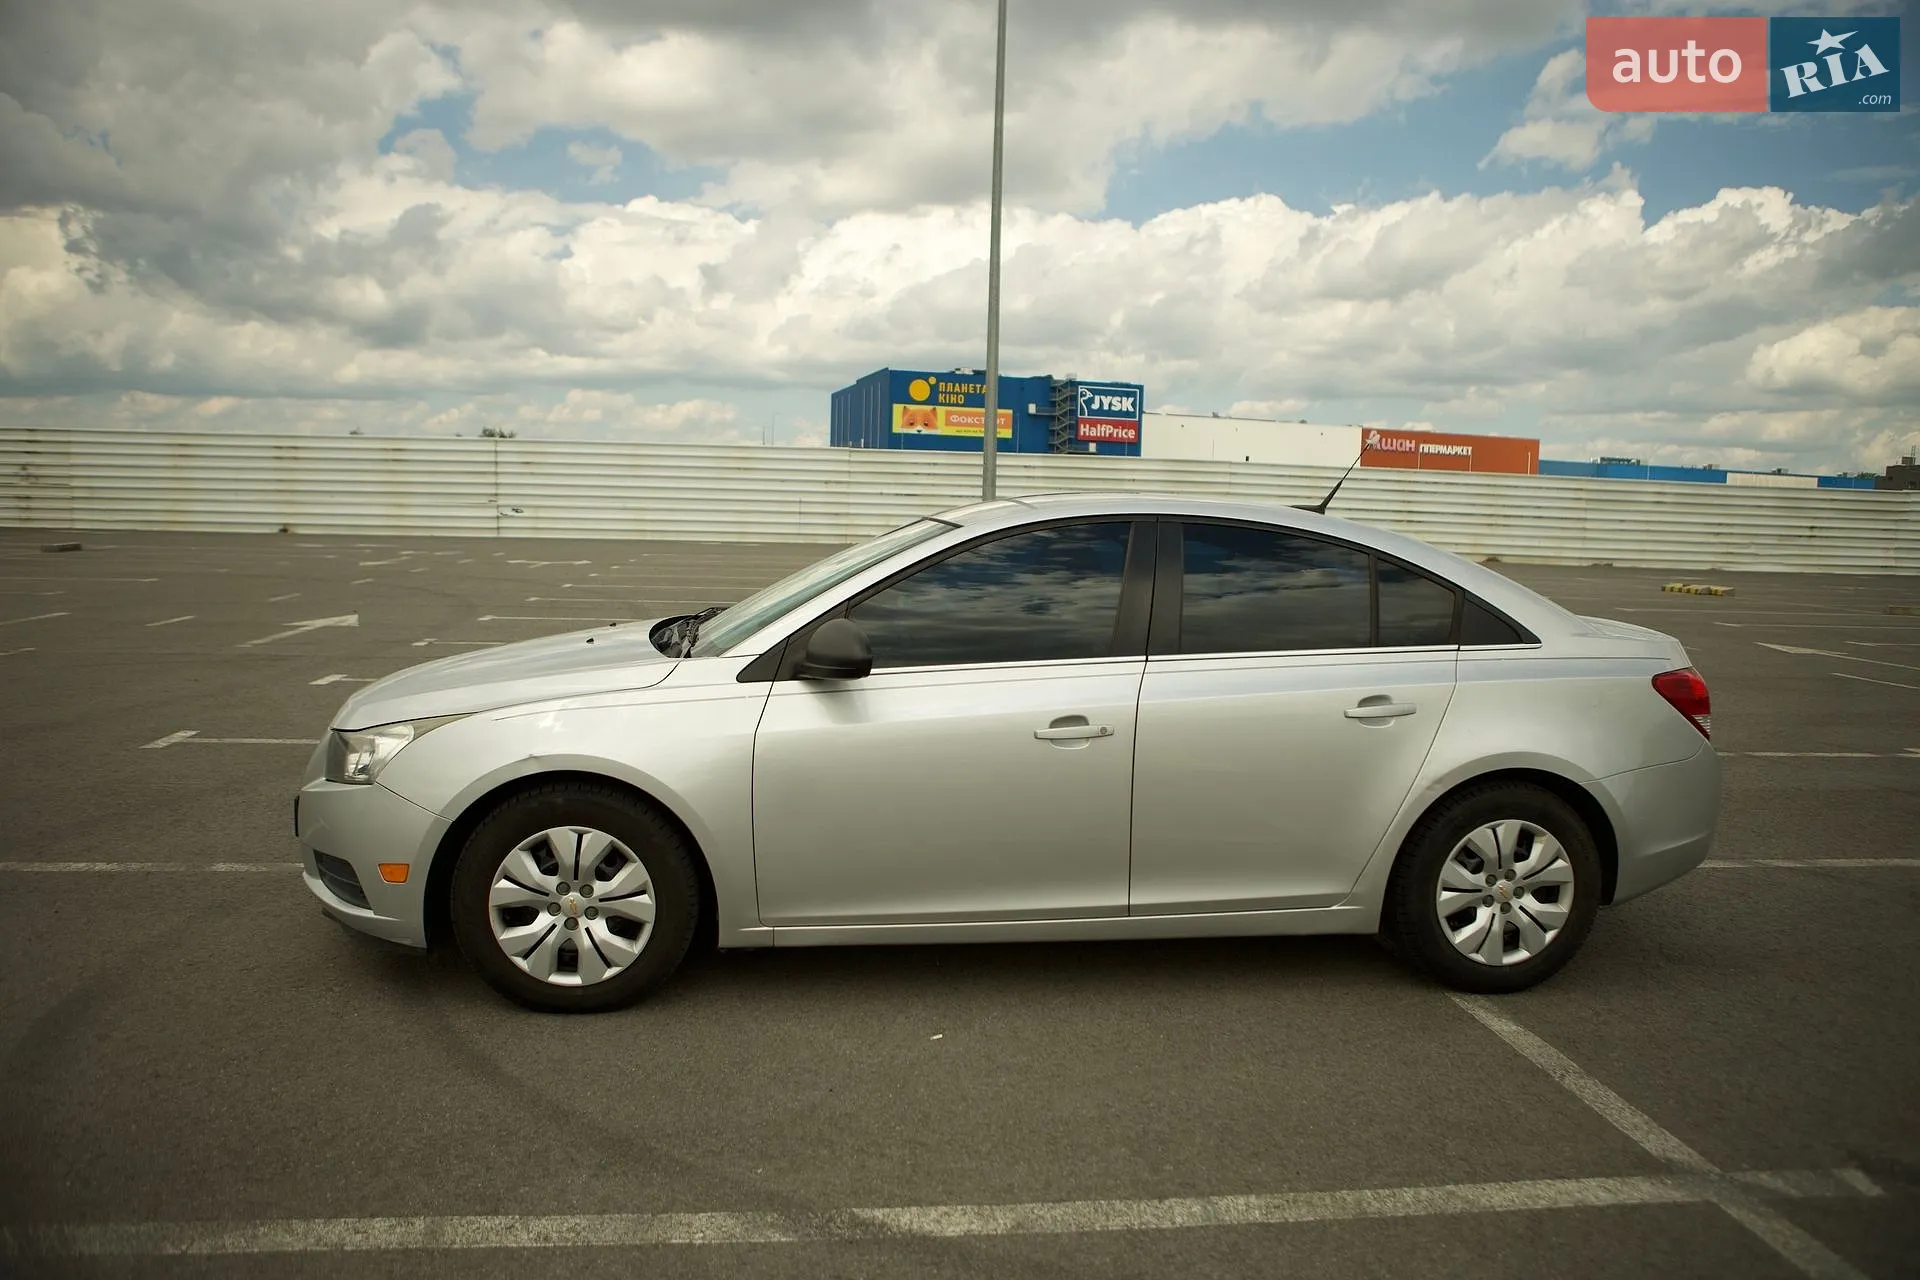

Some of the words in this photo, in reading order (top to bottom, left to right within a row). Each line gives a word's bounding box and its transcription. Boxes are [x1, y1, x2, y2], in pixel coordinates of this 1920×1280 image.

[938, 393, 965, 404] КІНО
[1091, 395, 1134, 412] JYSK
[1080, 423, 1136, 438] HalfPrice
[1366, 430, 1416, 452] Ашан
